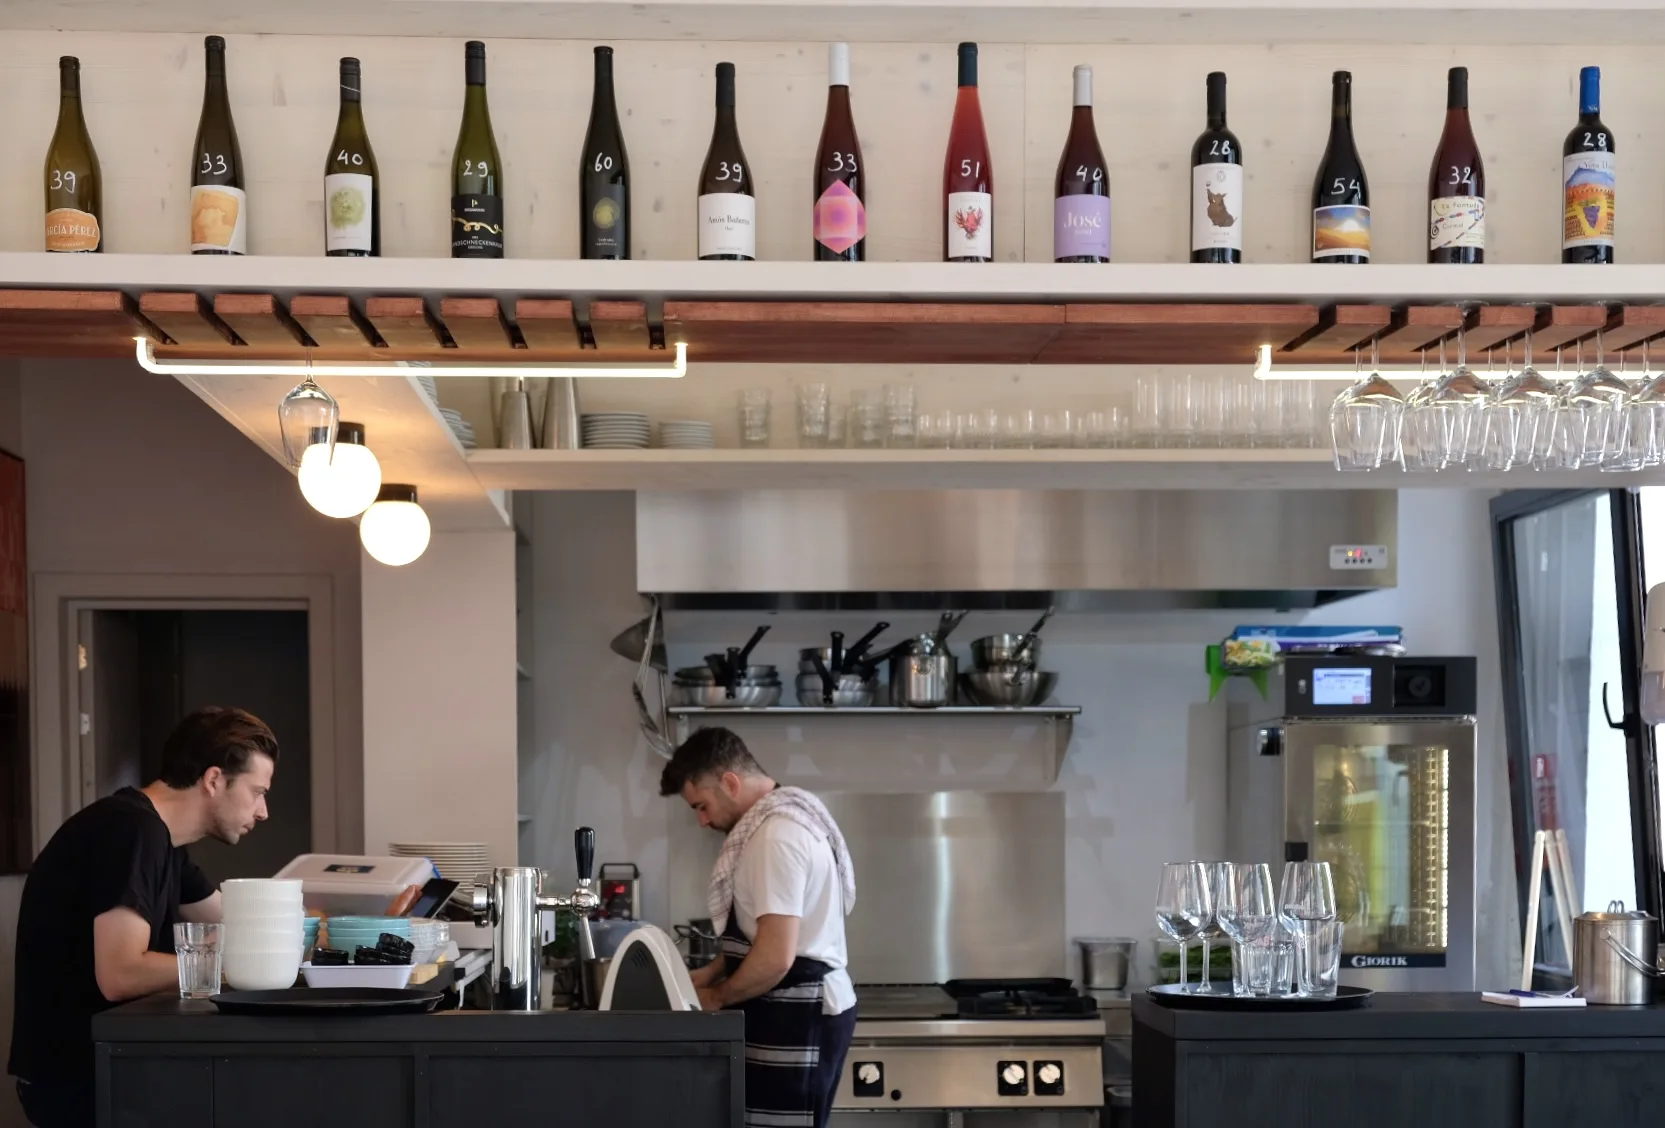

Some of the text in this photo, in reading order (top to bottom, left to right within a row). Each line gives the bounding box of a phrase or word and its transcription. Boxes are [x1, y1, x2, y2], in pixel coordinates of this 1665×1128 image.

[1209, 139, 1231, 156] 28
[1583, 132, 1607, 147] 28
[201, 152, 228, 176] 33
[337, 149, 364, 166] 40
[594, 152, 613, 173] 60
[827, 151, 858, 173] 33
[463, 159, 489, 178] 29
[715, 161, 743, 183] 39
[960, 159, 980, 178] 51
[1075, 164, 1103, 182] 40
[1448, 166, 1472, 185] 32
[50, 169, 77, 194] 39
[1330, 177, 1361, 200] 54
[1063, 210, 1102, 228] José
[69, 222, 97, 238] PÉREZ
[1350, 954, 1409, 968] GIORIK
